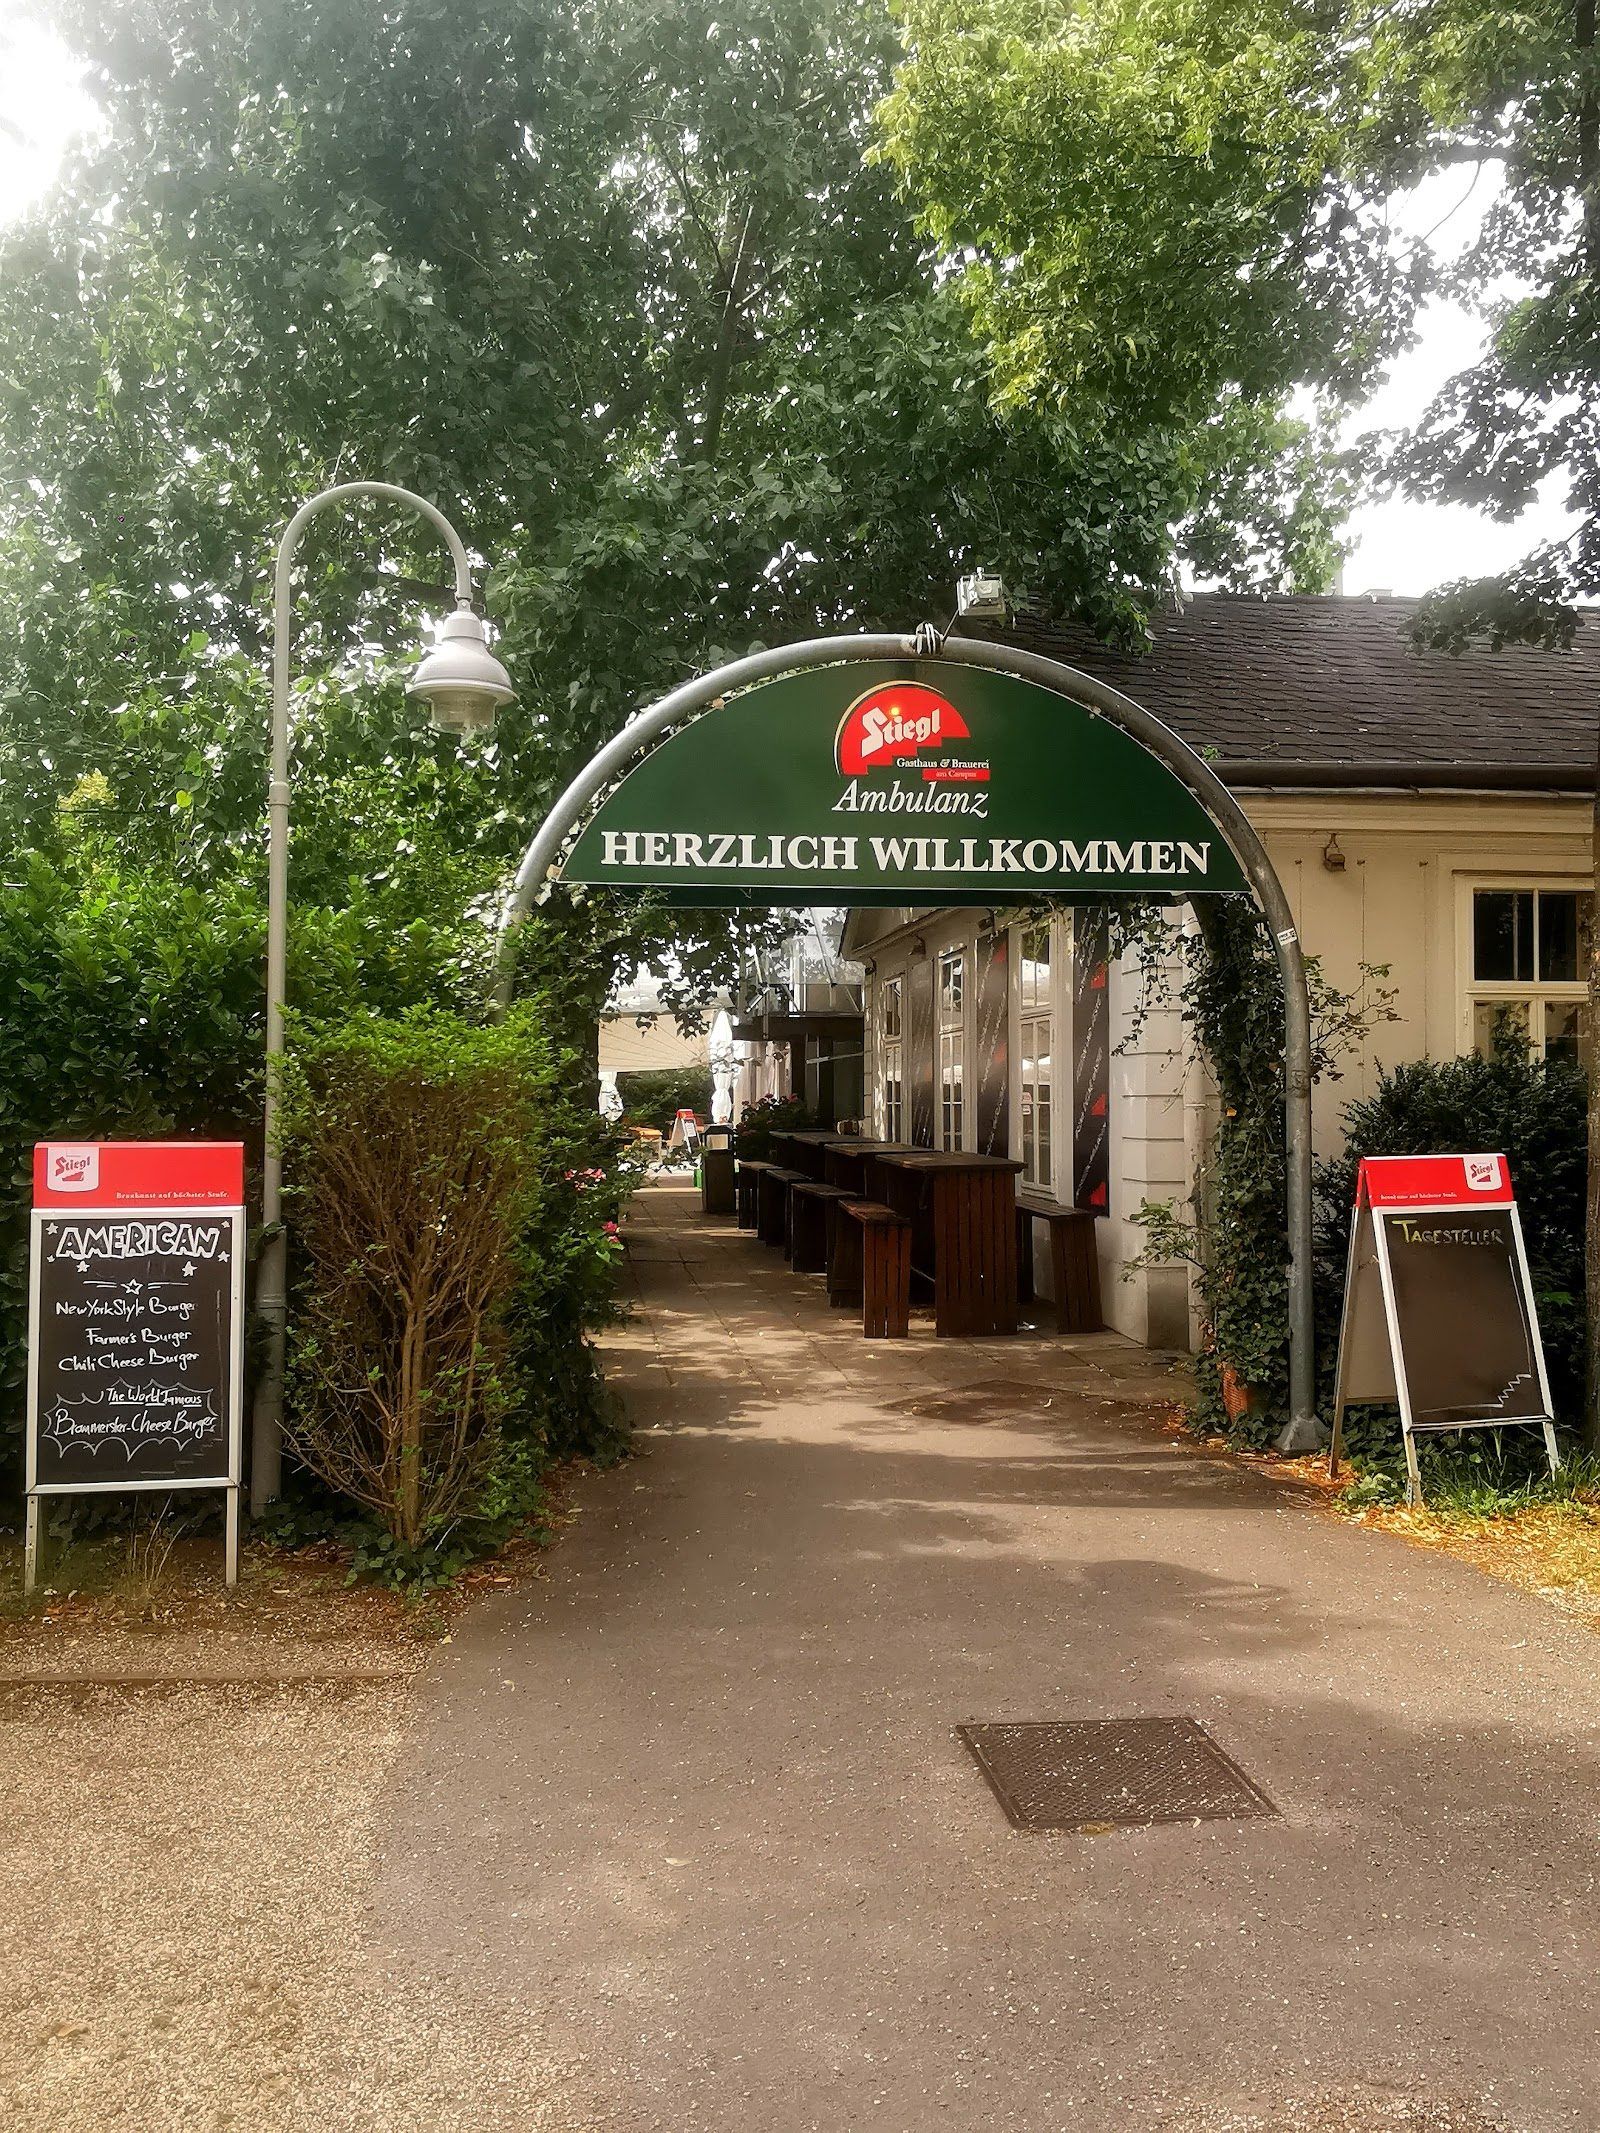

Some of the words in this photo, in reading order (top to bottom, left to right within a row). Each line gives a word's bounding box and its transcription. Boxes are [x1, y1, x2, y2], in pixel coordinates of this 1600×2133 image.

[861, 706, 941, 758] Stiegl
[896, 757, 938, 768] Gasthaus
[939, 758, 950, 768] &
[951, 758, 990, 769] Brauerei
[832, 778, 989, 819] Ambulanz
[601, 831, 859, 870] HERZLICH
[869, 837, 1211, 875] WILLKOMMEN
[55, 1155, 91, 1177] Stiegl
[56, 1221, 220, 1261] AMERICAN
[1392, 1219, 1505, 1246] TAGESTELLER
[85, 1327, 138, 1345] Farmer's
[141, 1327, 192, 1348] Burger
[58, 1355, 97, 1371] Chili
[97, 1352, 145, 1370] Cheese
[149, 1347, 200, 1371] Burger
[106, 1387, 125, 1402] The
[127, 1384, 160, 1402] World
[172, 1409, 217, 1439] Burger
